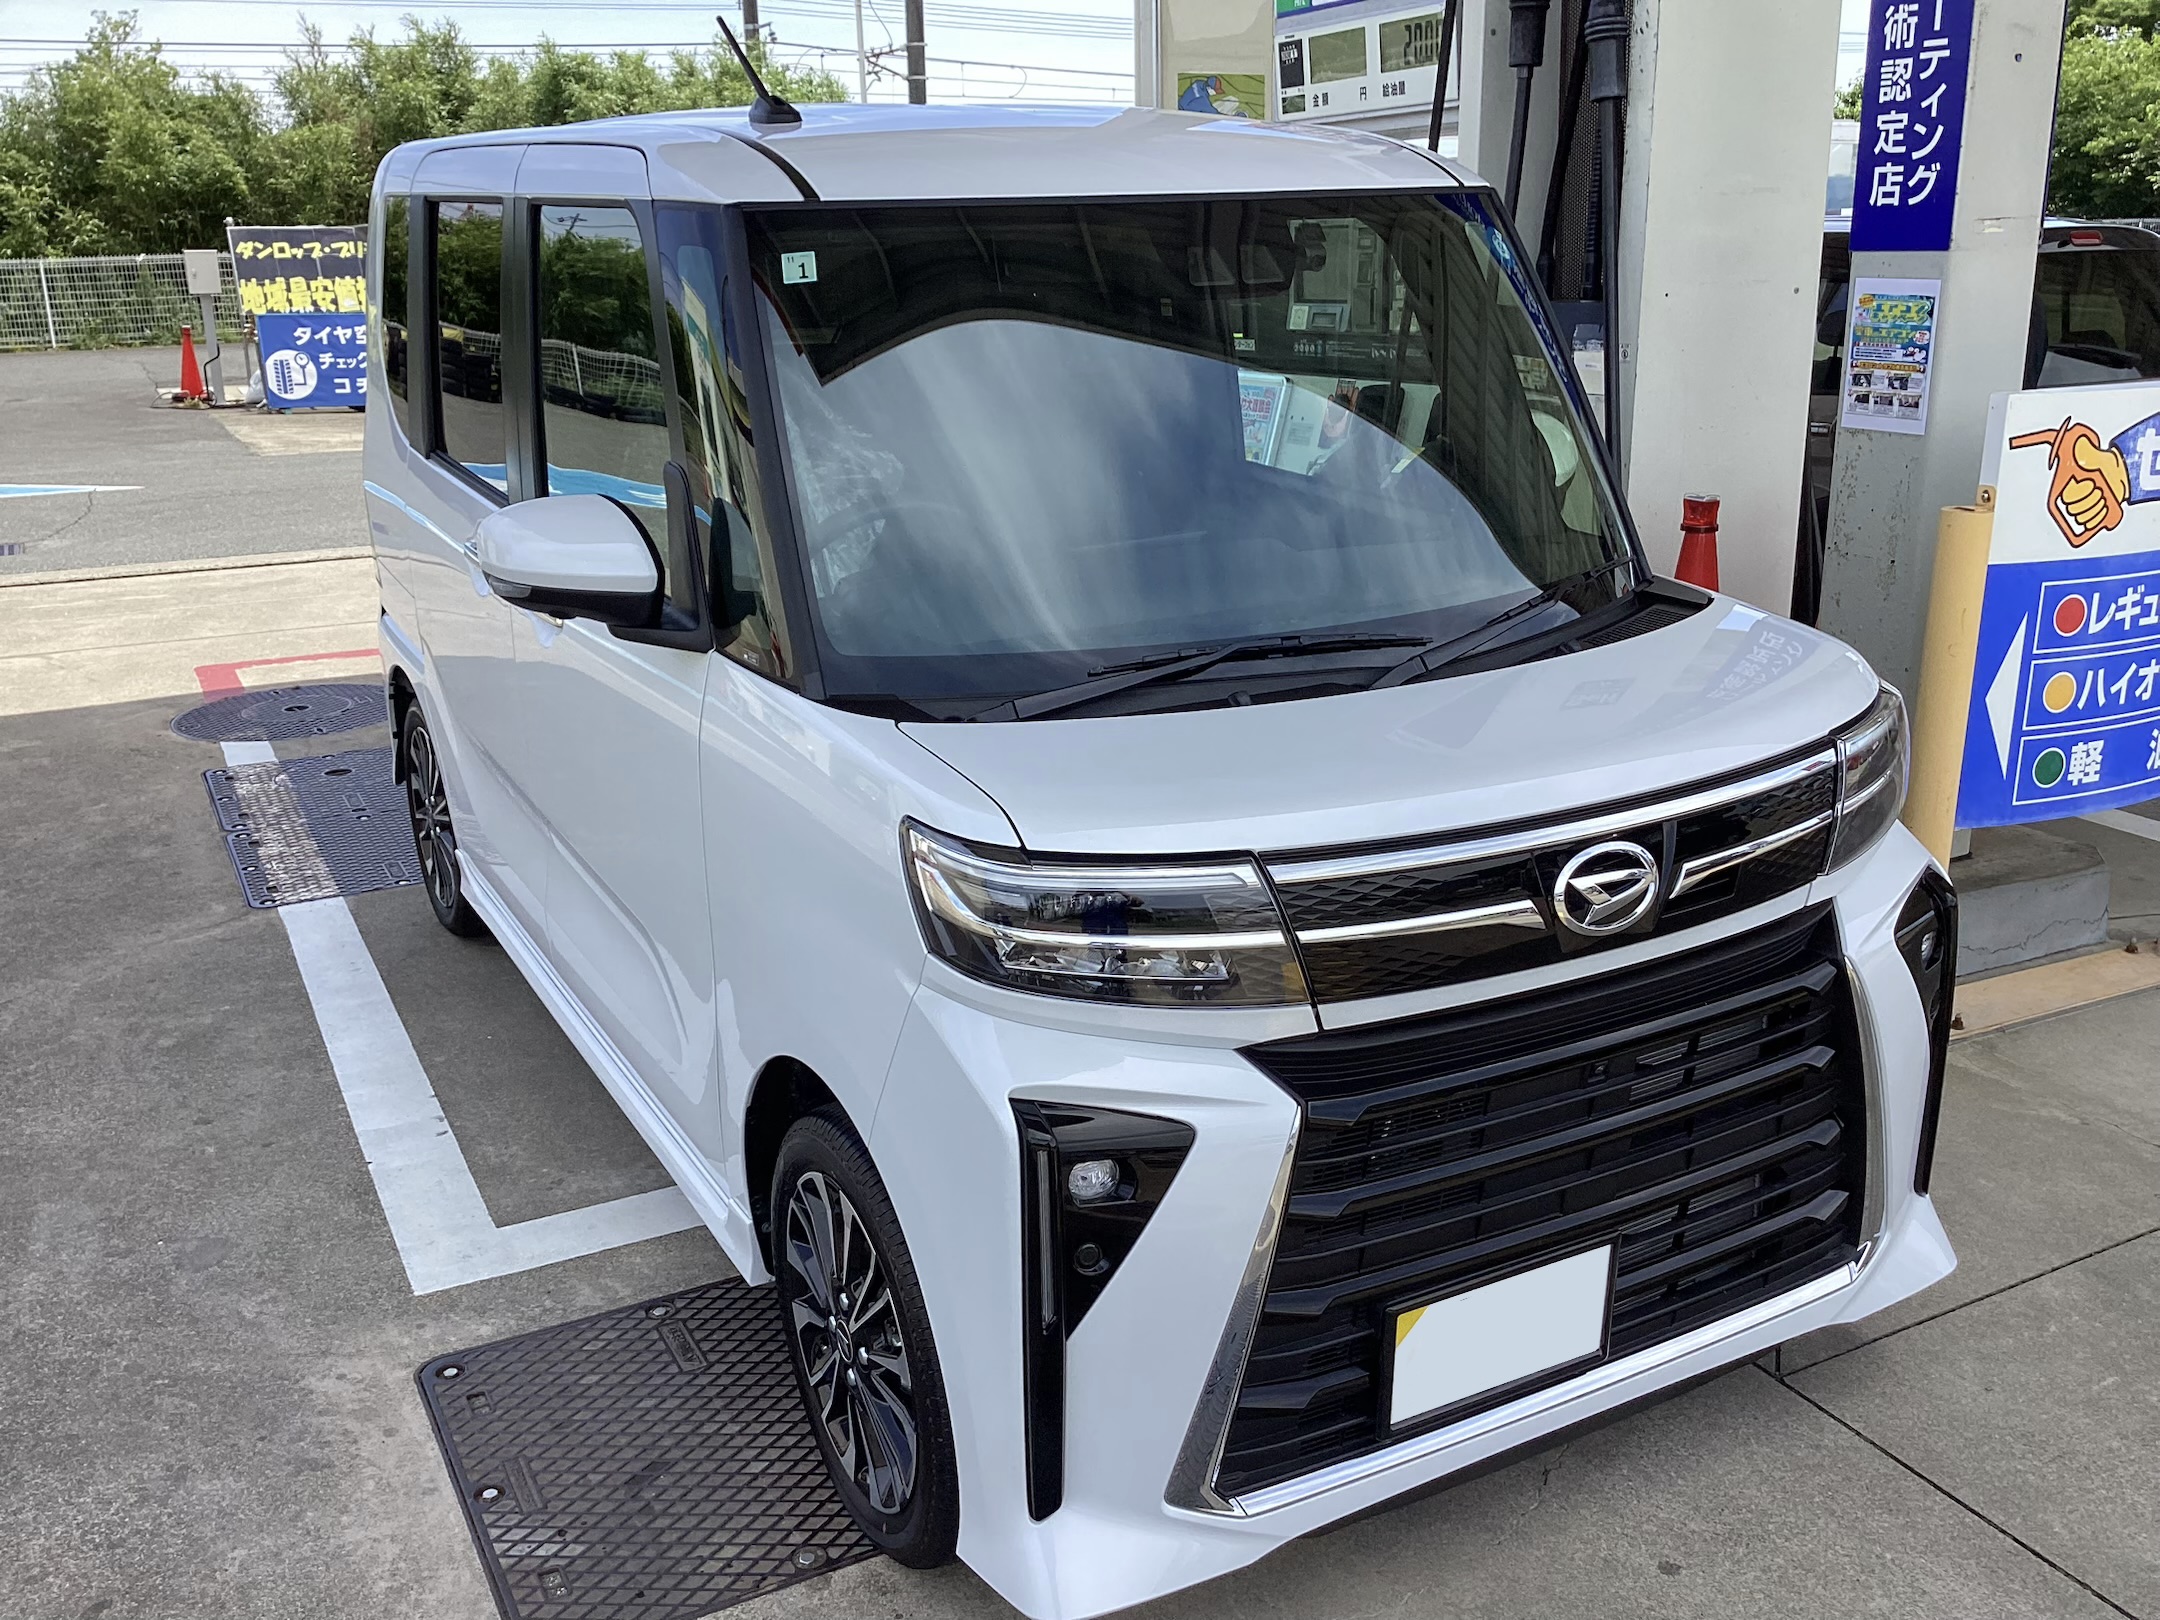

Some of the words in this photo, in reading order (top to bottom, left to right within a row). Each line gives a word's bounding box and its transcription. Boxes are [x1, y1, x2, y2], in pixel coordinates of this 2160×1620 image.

[1869, 3, 1920, 207] 術認定店
[235, 241, 367, 260] ダンロップ・ブリ
[798, 262, 809, 279] 1
[2088, 584, 2160, 635] レギュ
